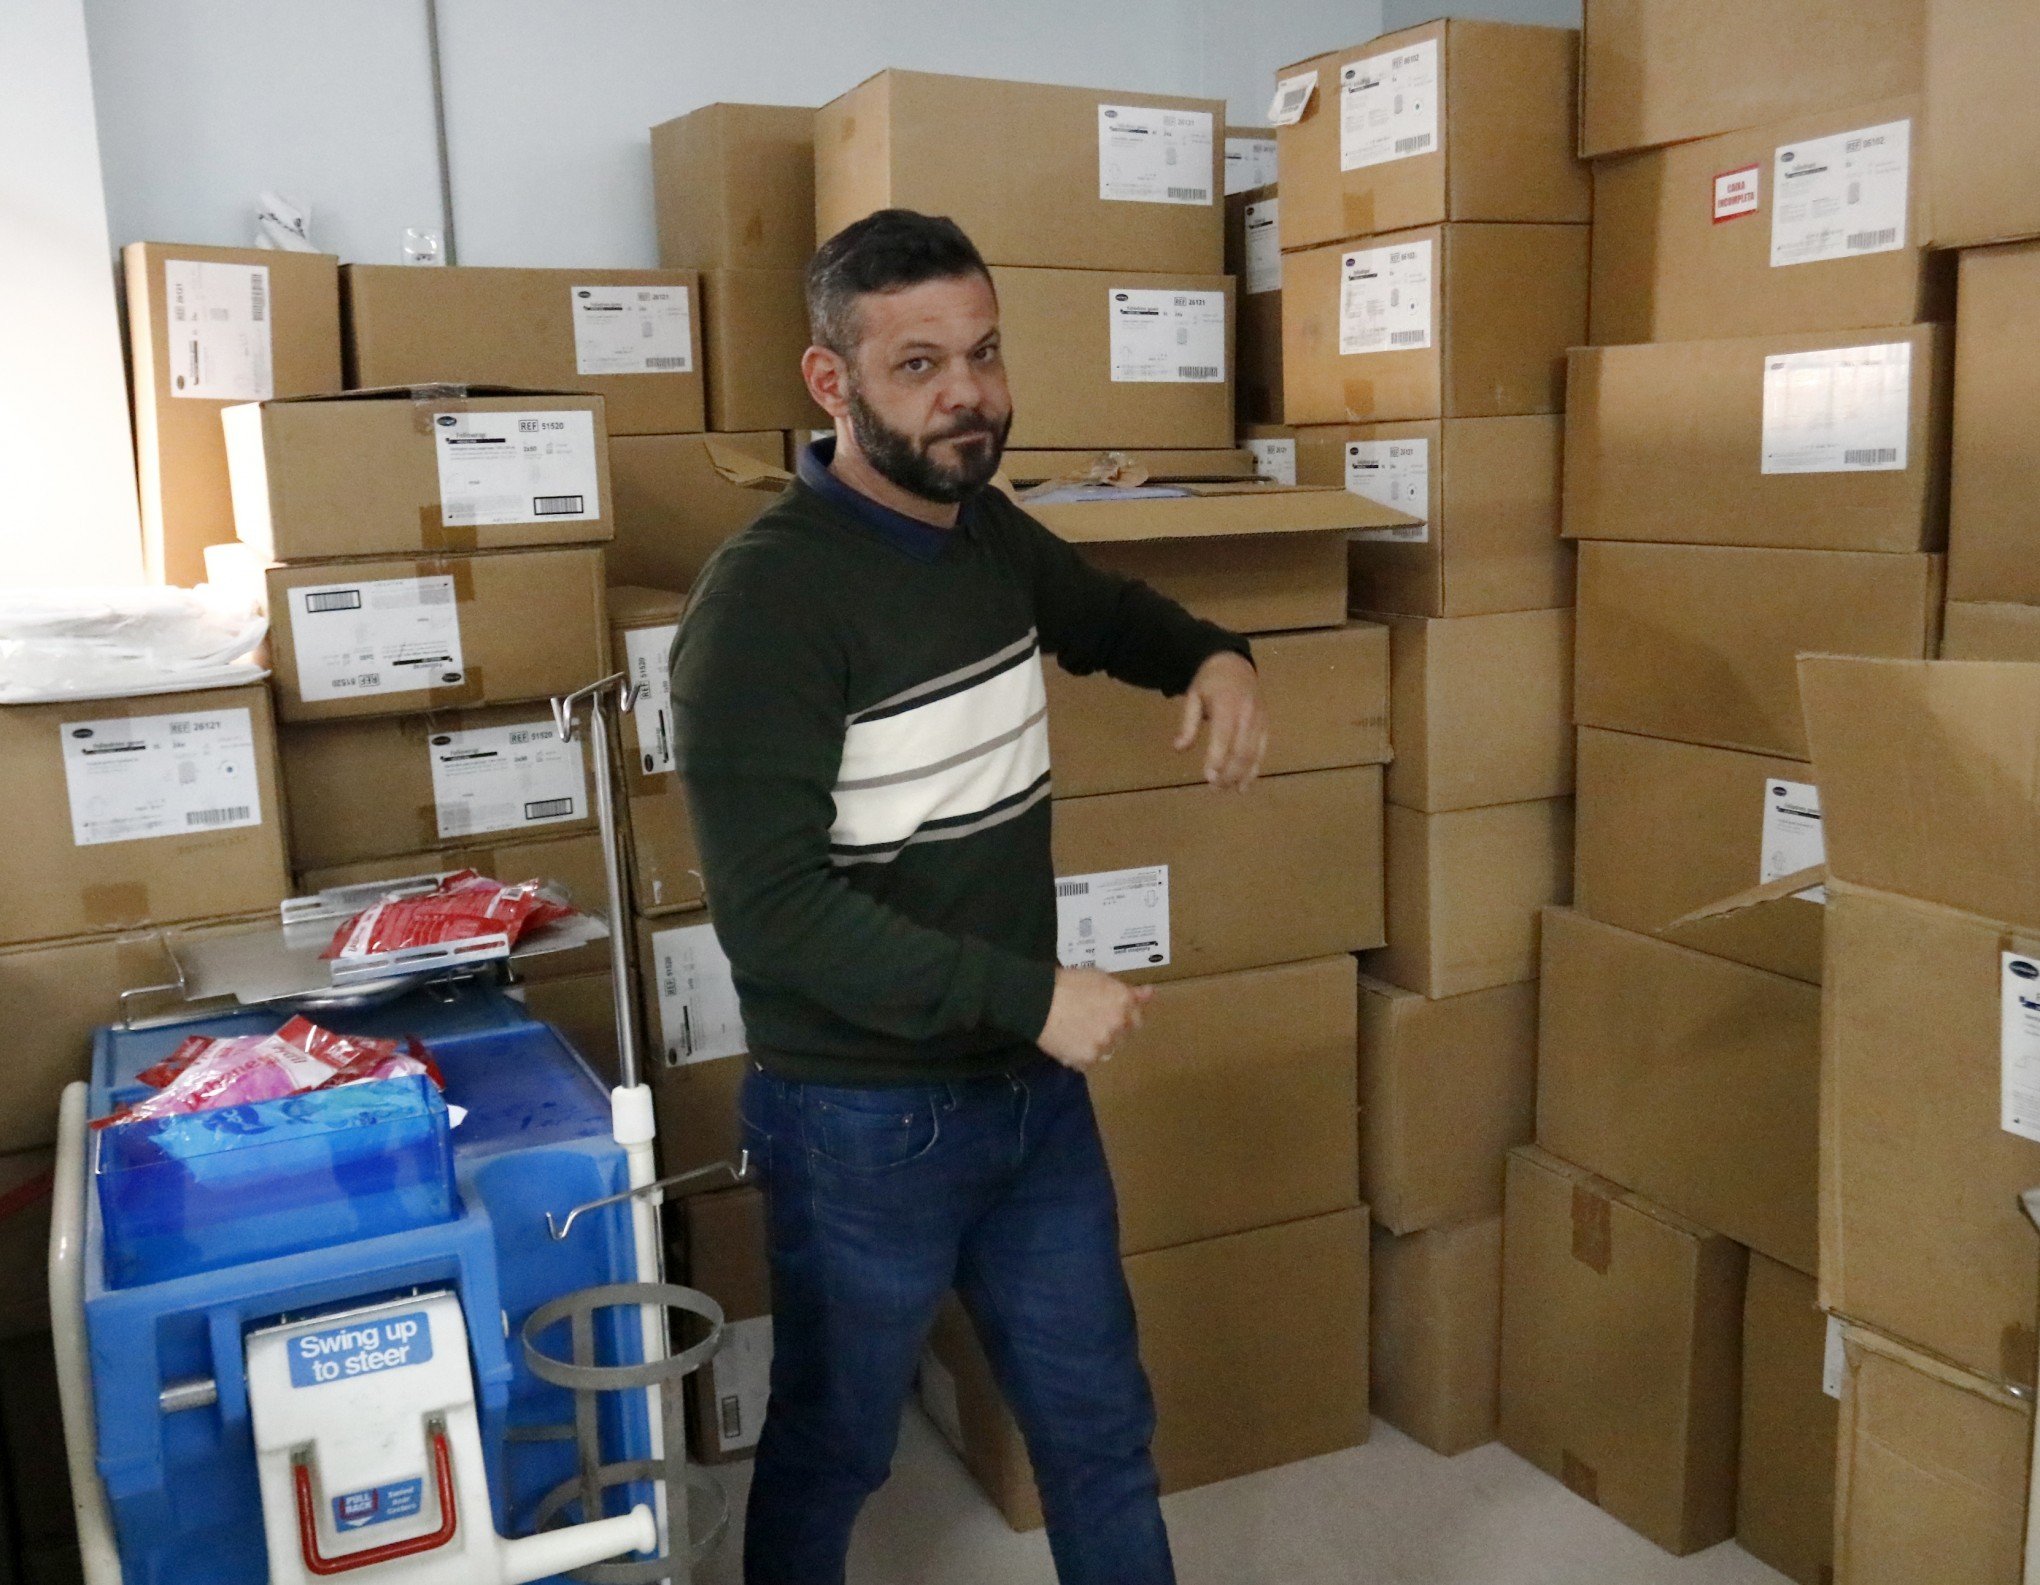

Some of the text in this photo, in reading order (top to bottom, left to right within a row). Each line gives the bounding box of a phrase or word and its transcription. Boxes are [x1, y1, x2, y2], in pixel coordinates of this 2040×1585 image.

[1727, 181, 1745, 193] CAIXA
[1718, 192, 1754, 208] INCOMPLETA
[520, 421, 564, 432] REF 51520
[360, 674, 378, 687] REF
[638, 657, 651, 699] REF 51520
[193, 722, 221, 731] 26121
[511, 732, 553, 744] REF 51520
[300, 1321, 417, 1358] Swing up
[312, 1345, 410, 1381] to steer
